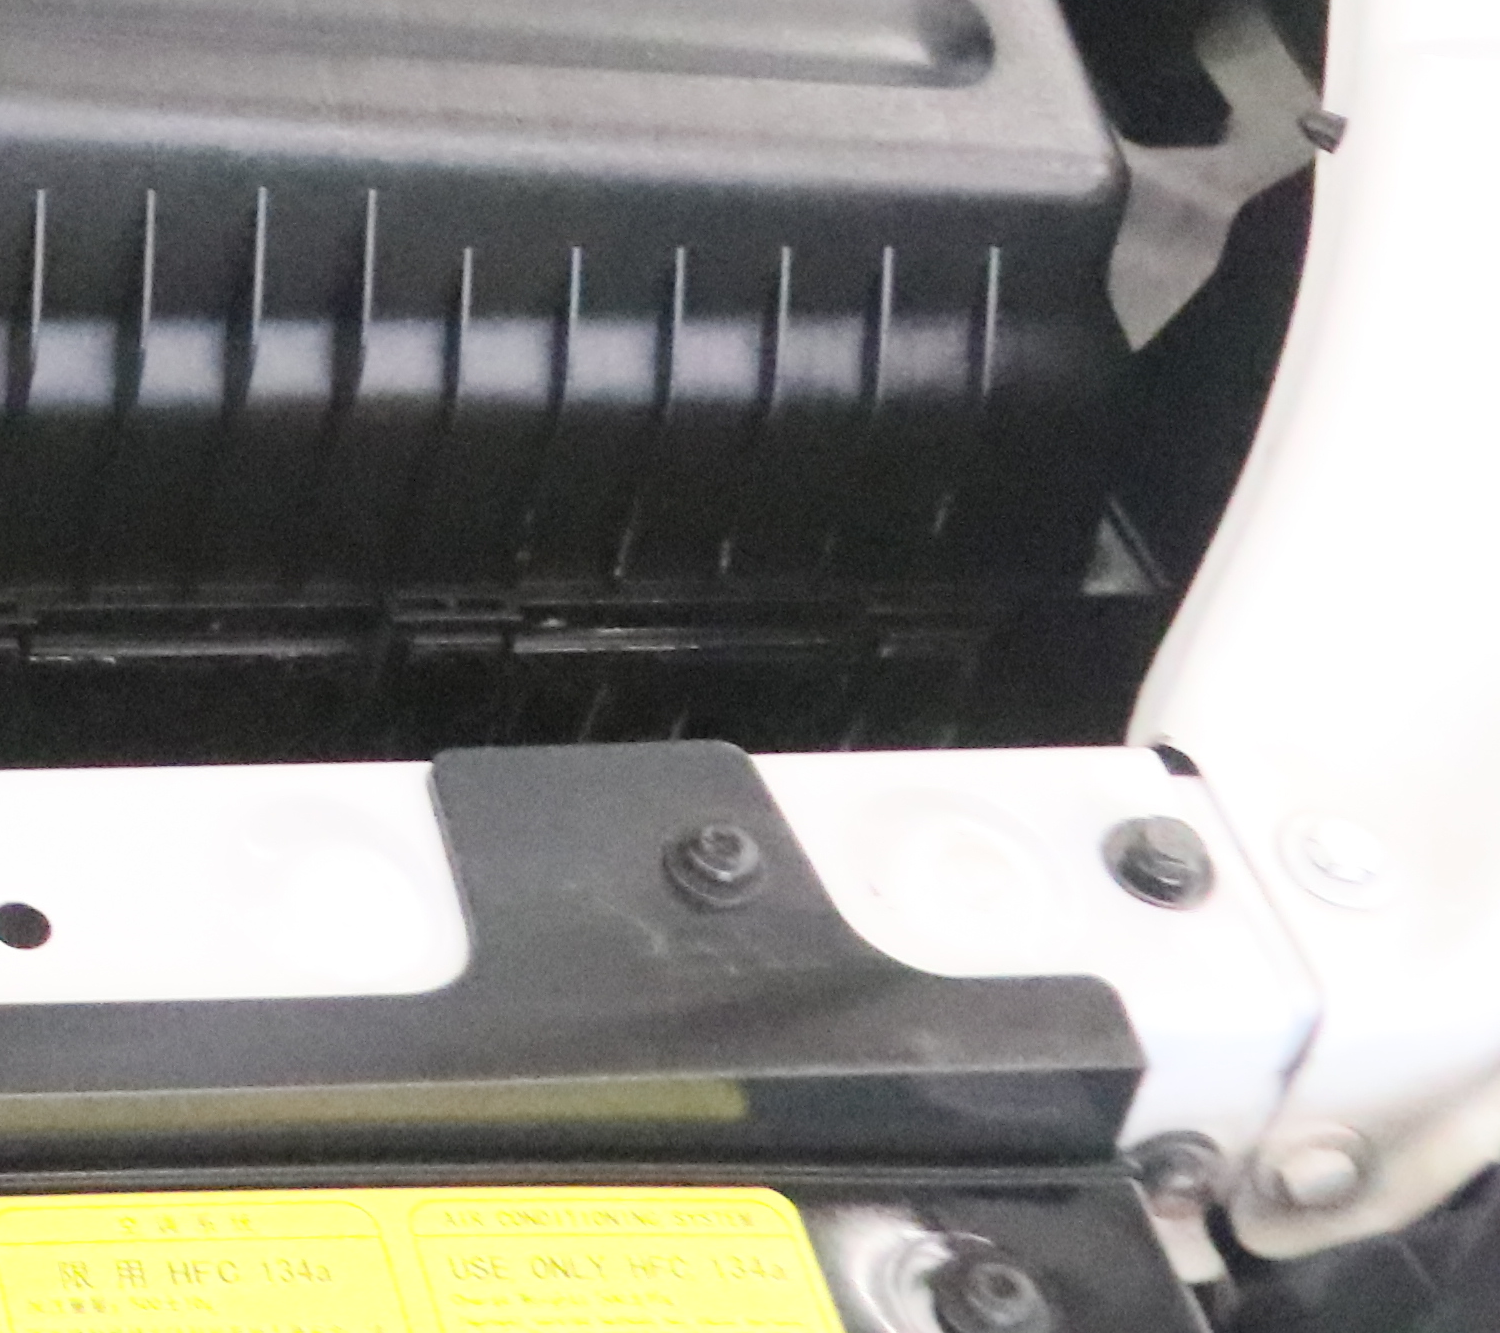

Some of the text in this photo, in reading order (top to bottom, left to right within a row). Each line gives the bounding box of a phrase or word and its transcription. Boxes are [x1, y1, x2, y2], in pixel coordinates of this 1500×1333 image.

[443, 1210, 483, 1229] AIR
[673, 1209, 756, 1228] SYSTEM
[166, 1259, 241, 1287] HFC
[260, 1258, 334, 1286] 134a
[446, 1254, 793, 1283] USE ONLY HFC 134a
